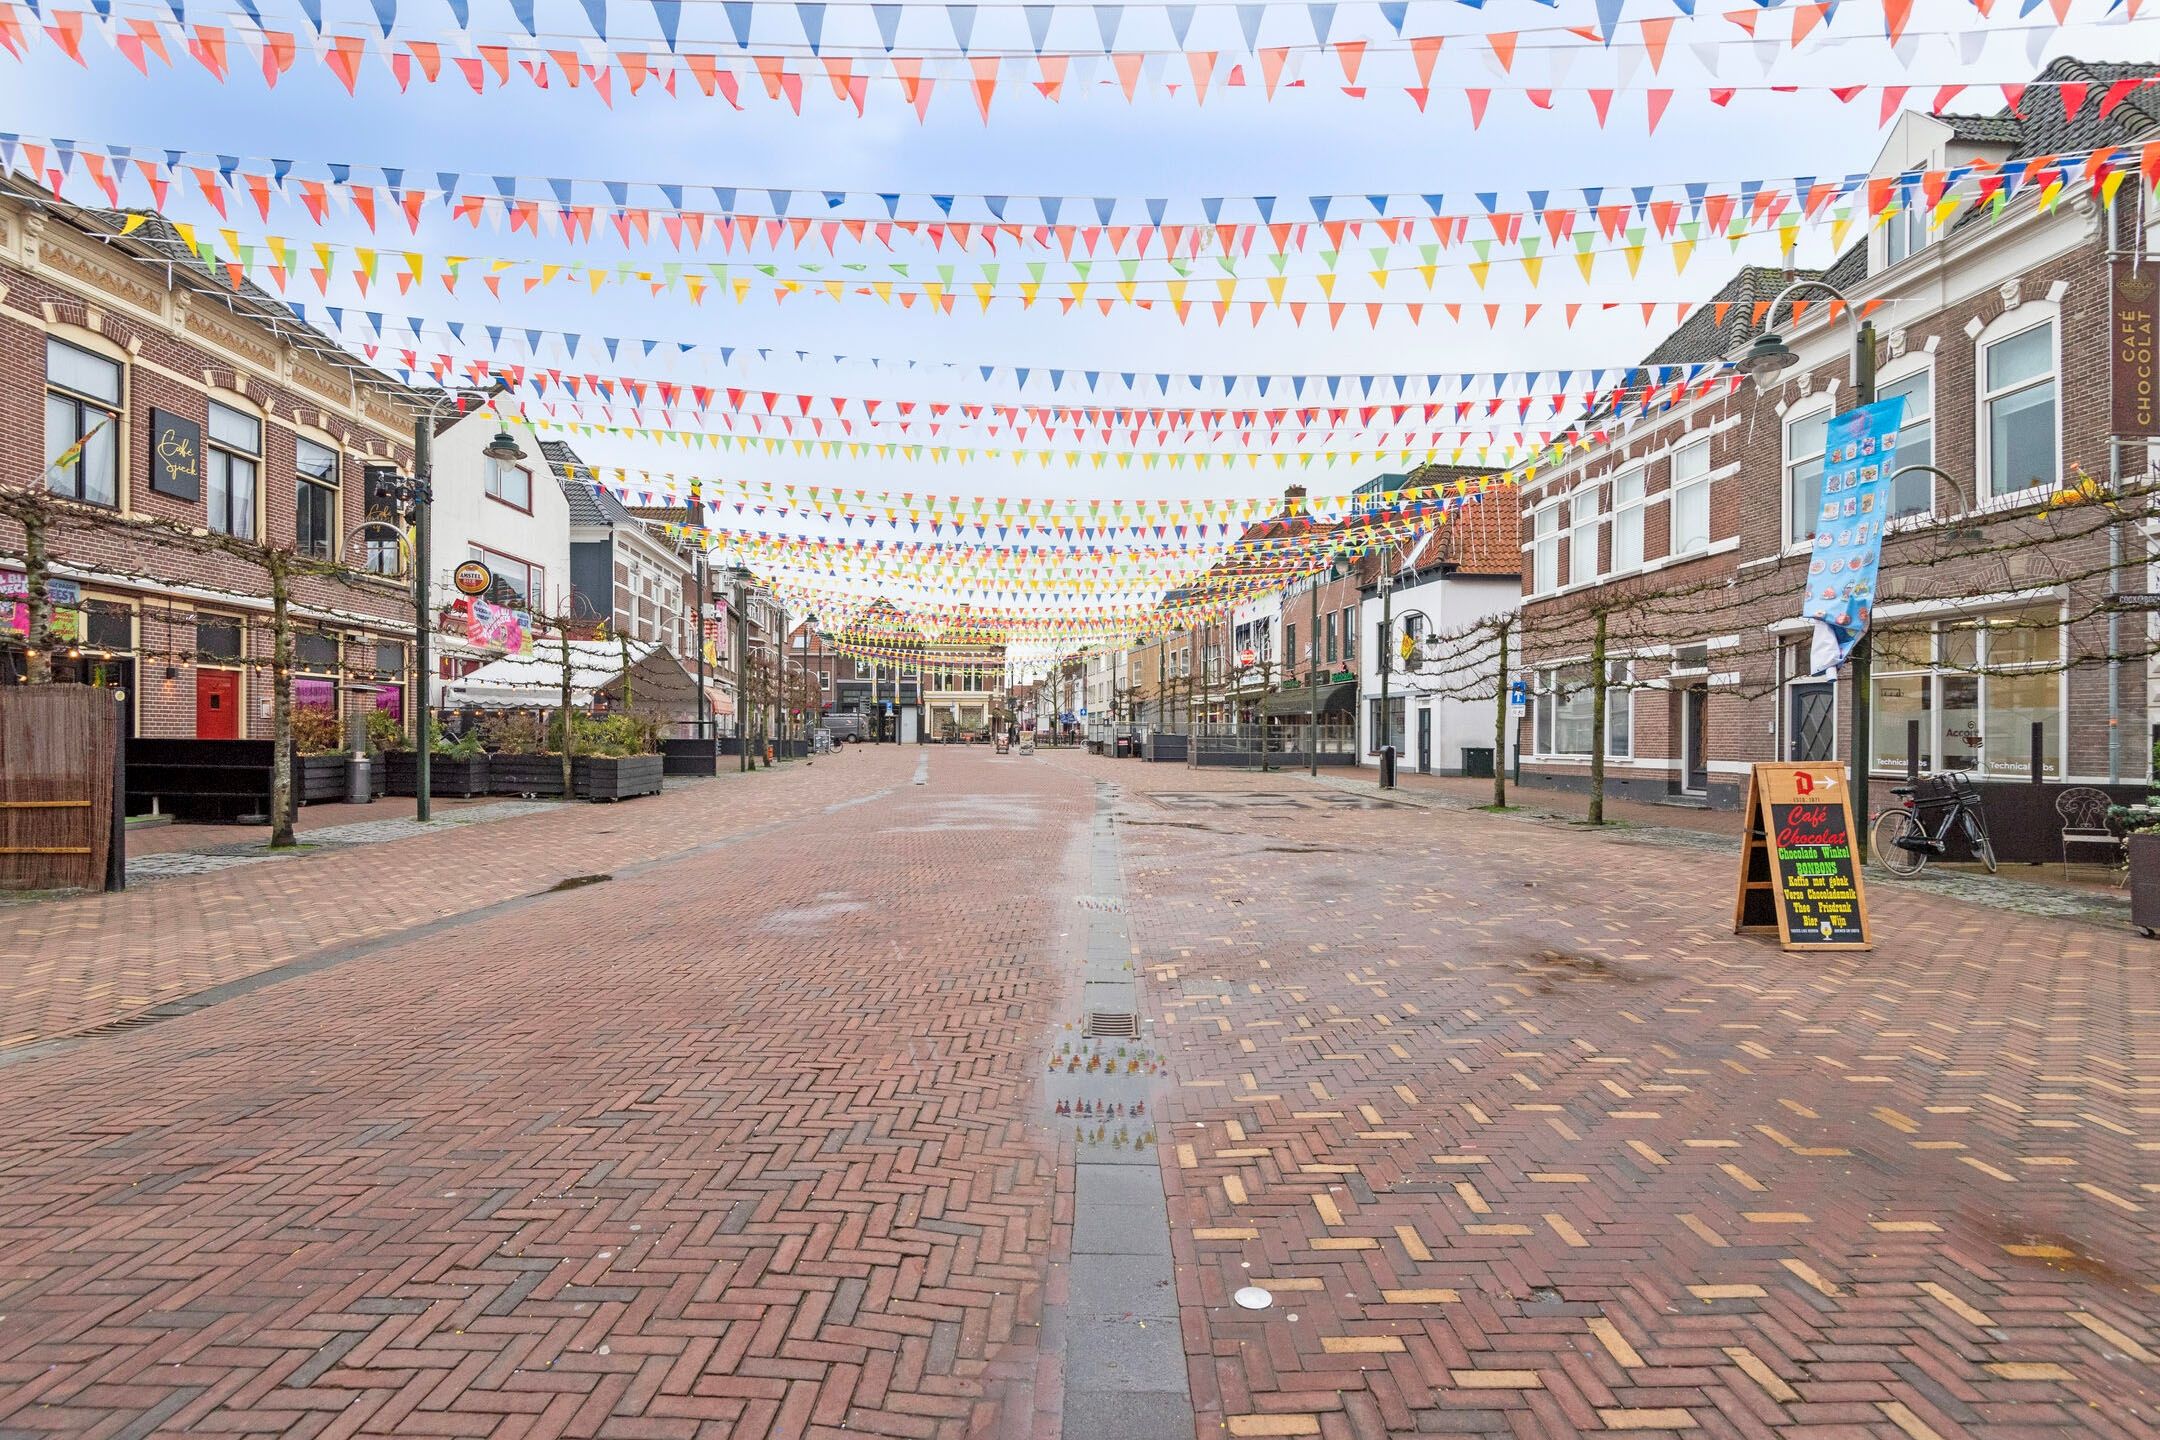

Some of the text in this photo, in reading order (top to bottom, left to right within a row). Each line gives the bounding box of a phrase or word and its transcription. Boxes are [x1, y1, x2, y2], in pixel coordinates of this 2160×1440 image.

[2118, 310, 2135, 362] CAFÉ
[2138, 310, 2151, 425] CHOCOLAT
[159, 429, 194, 458] Café
[166, 458, 198, 480] Sjieck
[1877, 758, 1909, 767] Technical
[1990, 761, 2031, 771] Technical
[1788, 806, 1827, 827] Café
[1776, 828, 1845, 848] Chocolat
[1778, 846, 1850, 860] Chocolade Winkel
[1795, 861, 1838, 874] BONBONS
[1788, 876, 1849, 889] Koffie met gebak
[1784, 889, 1857, 900] Verse Chocolademelk
[1793, 902, 1852, 913] Thee Frisdrank
[1803, 915, 1847, 929] Bier Wijn
